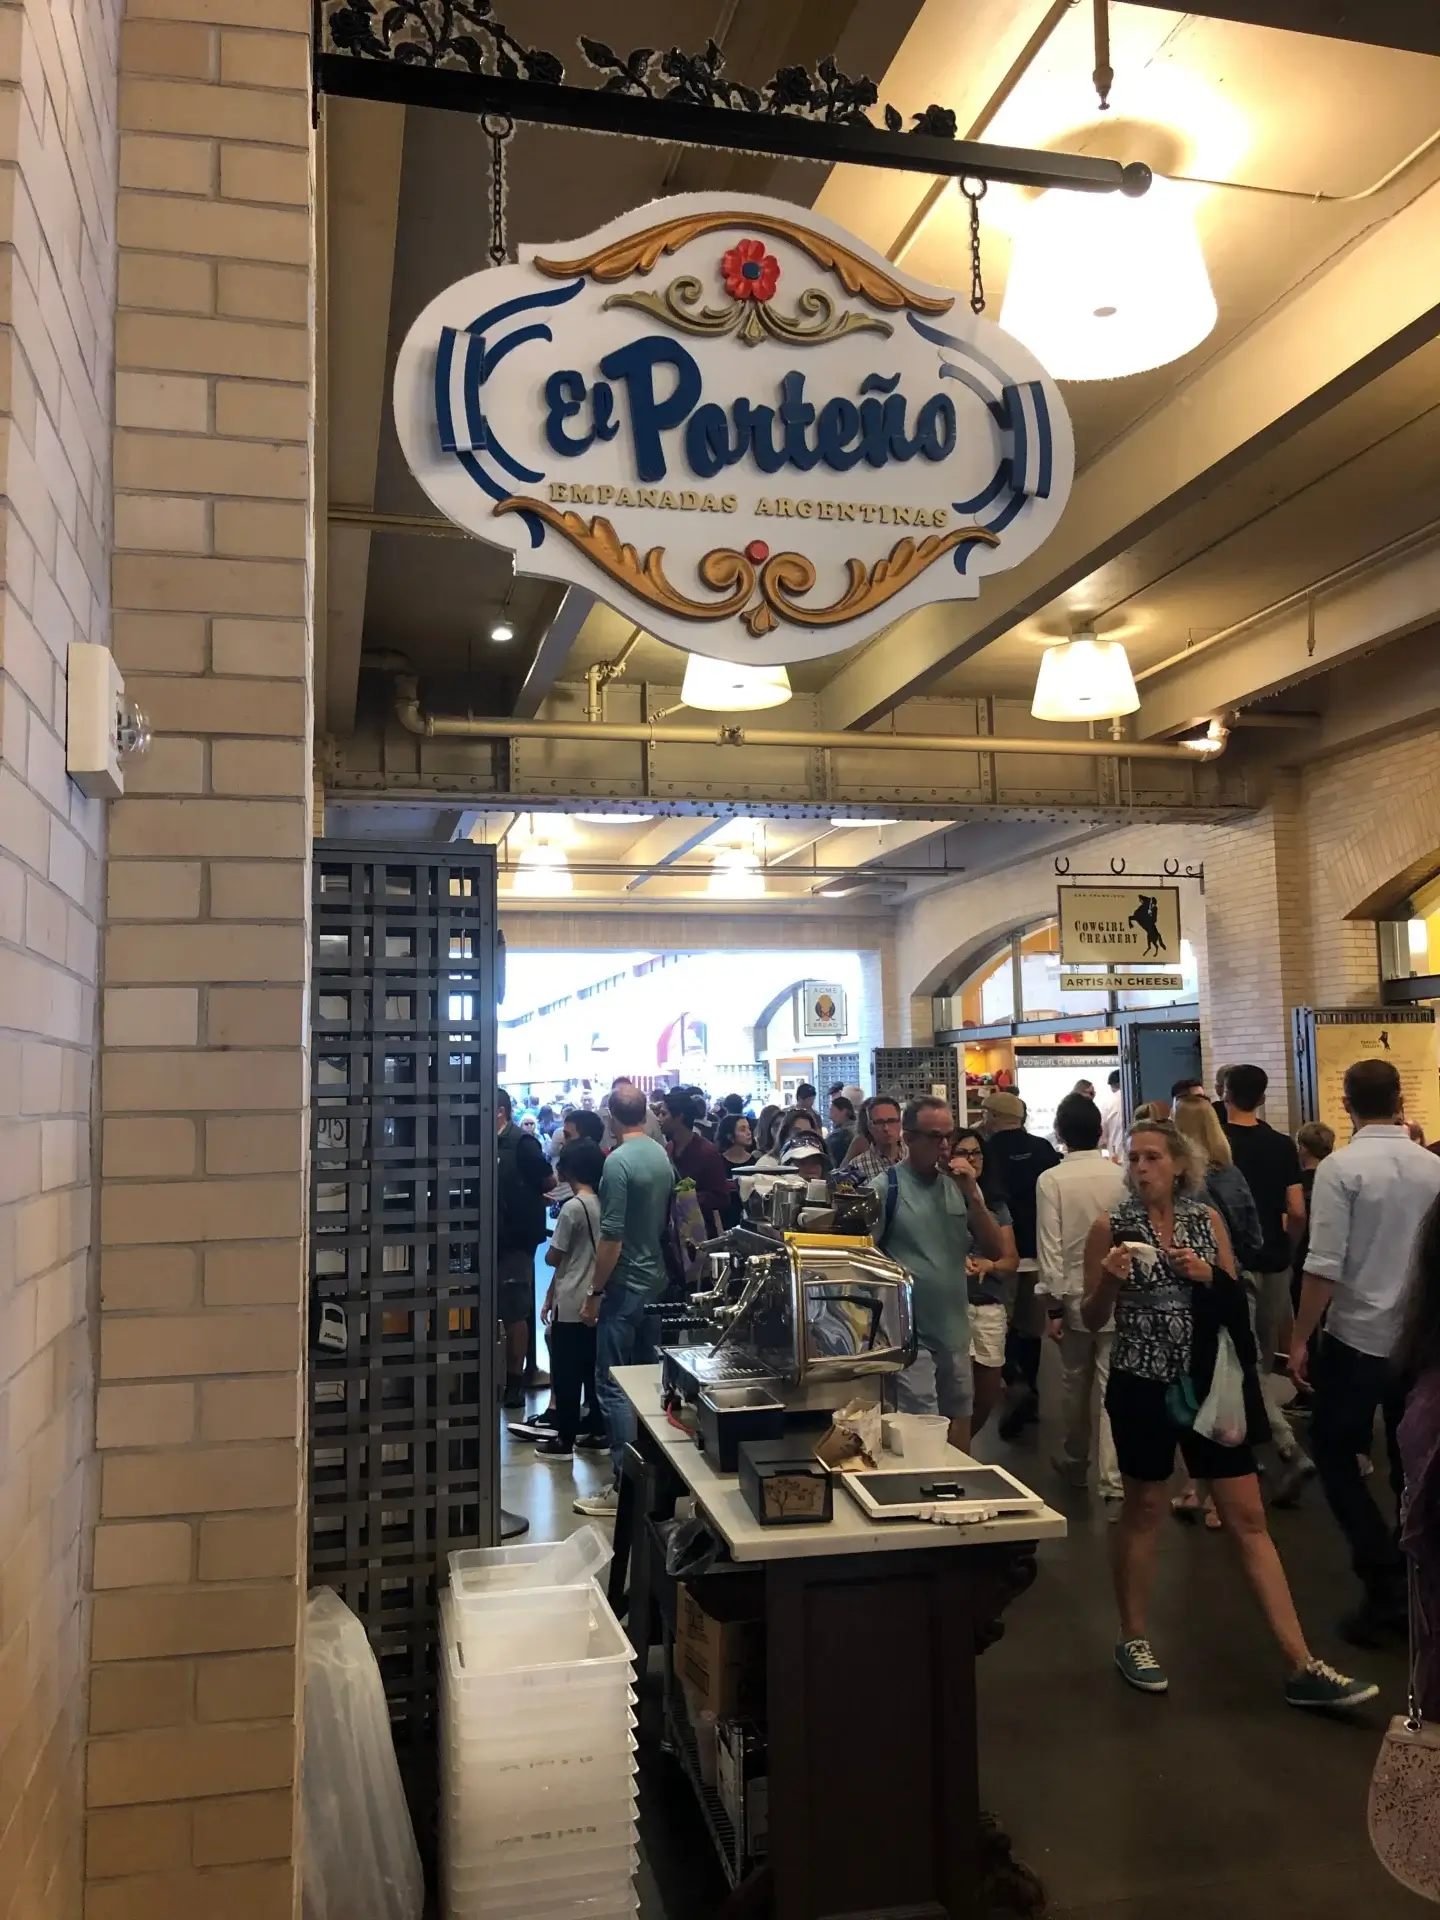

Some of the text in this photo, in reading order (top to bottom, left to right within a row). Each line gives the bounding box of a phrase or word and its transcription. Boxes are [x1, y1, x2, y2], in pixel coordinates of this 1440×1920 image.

[546, 335, 957, 482] El Porteño
[549, 483, 949, 528] EMPANADAS ARGENTINAS
[1074, 920, 1125, 932] COWGIRL
[1079, 931, 1138, 944] CREAMERY
[1066, 977, 1178, 987] ARTISAN CHEESE
